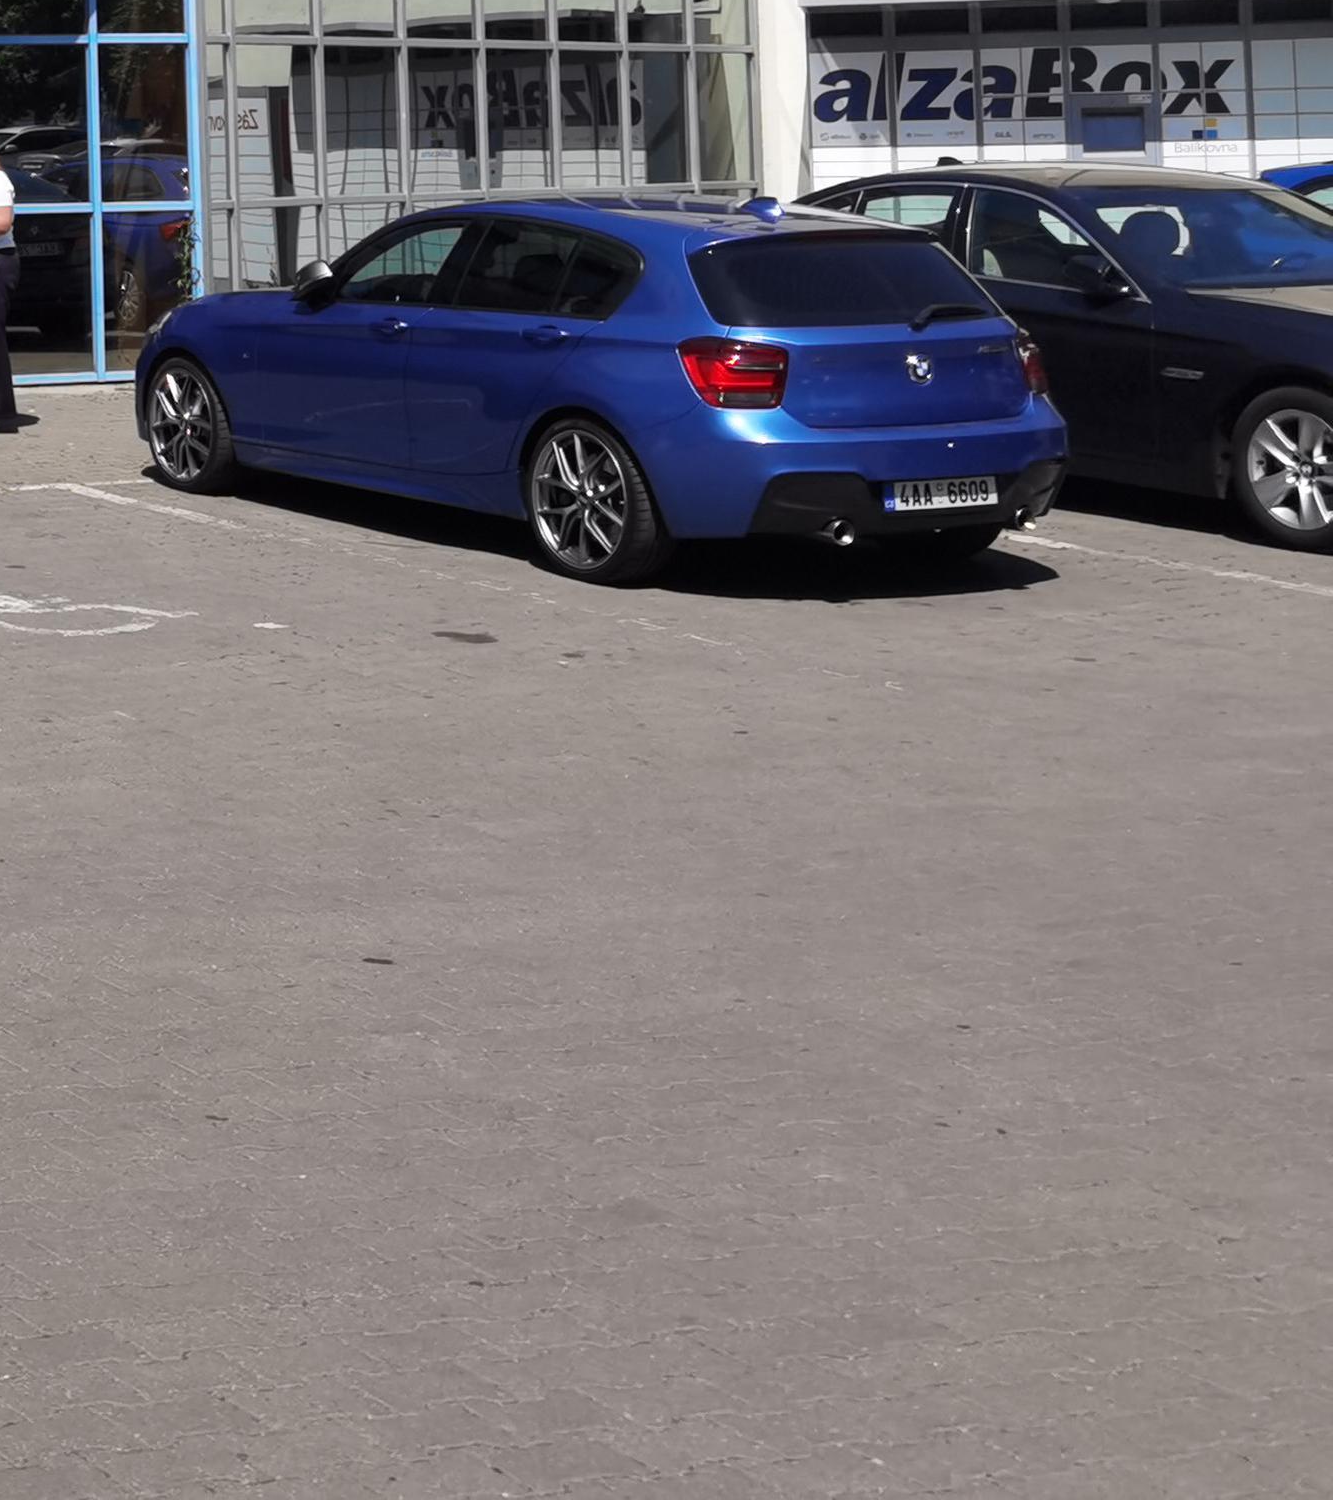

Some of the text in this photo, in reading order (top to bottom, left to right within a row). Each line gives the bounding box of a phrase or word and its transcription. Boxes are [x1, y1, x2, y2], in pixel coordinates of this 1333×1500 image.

[814, 47, 1236, 123] alzaBox
[900, 483, 933, 507] 4AA
[947, 480, 989, 504] 6609
